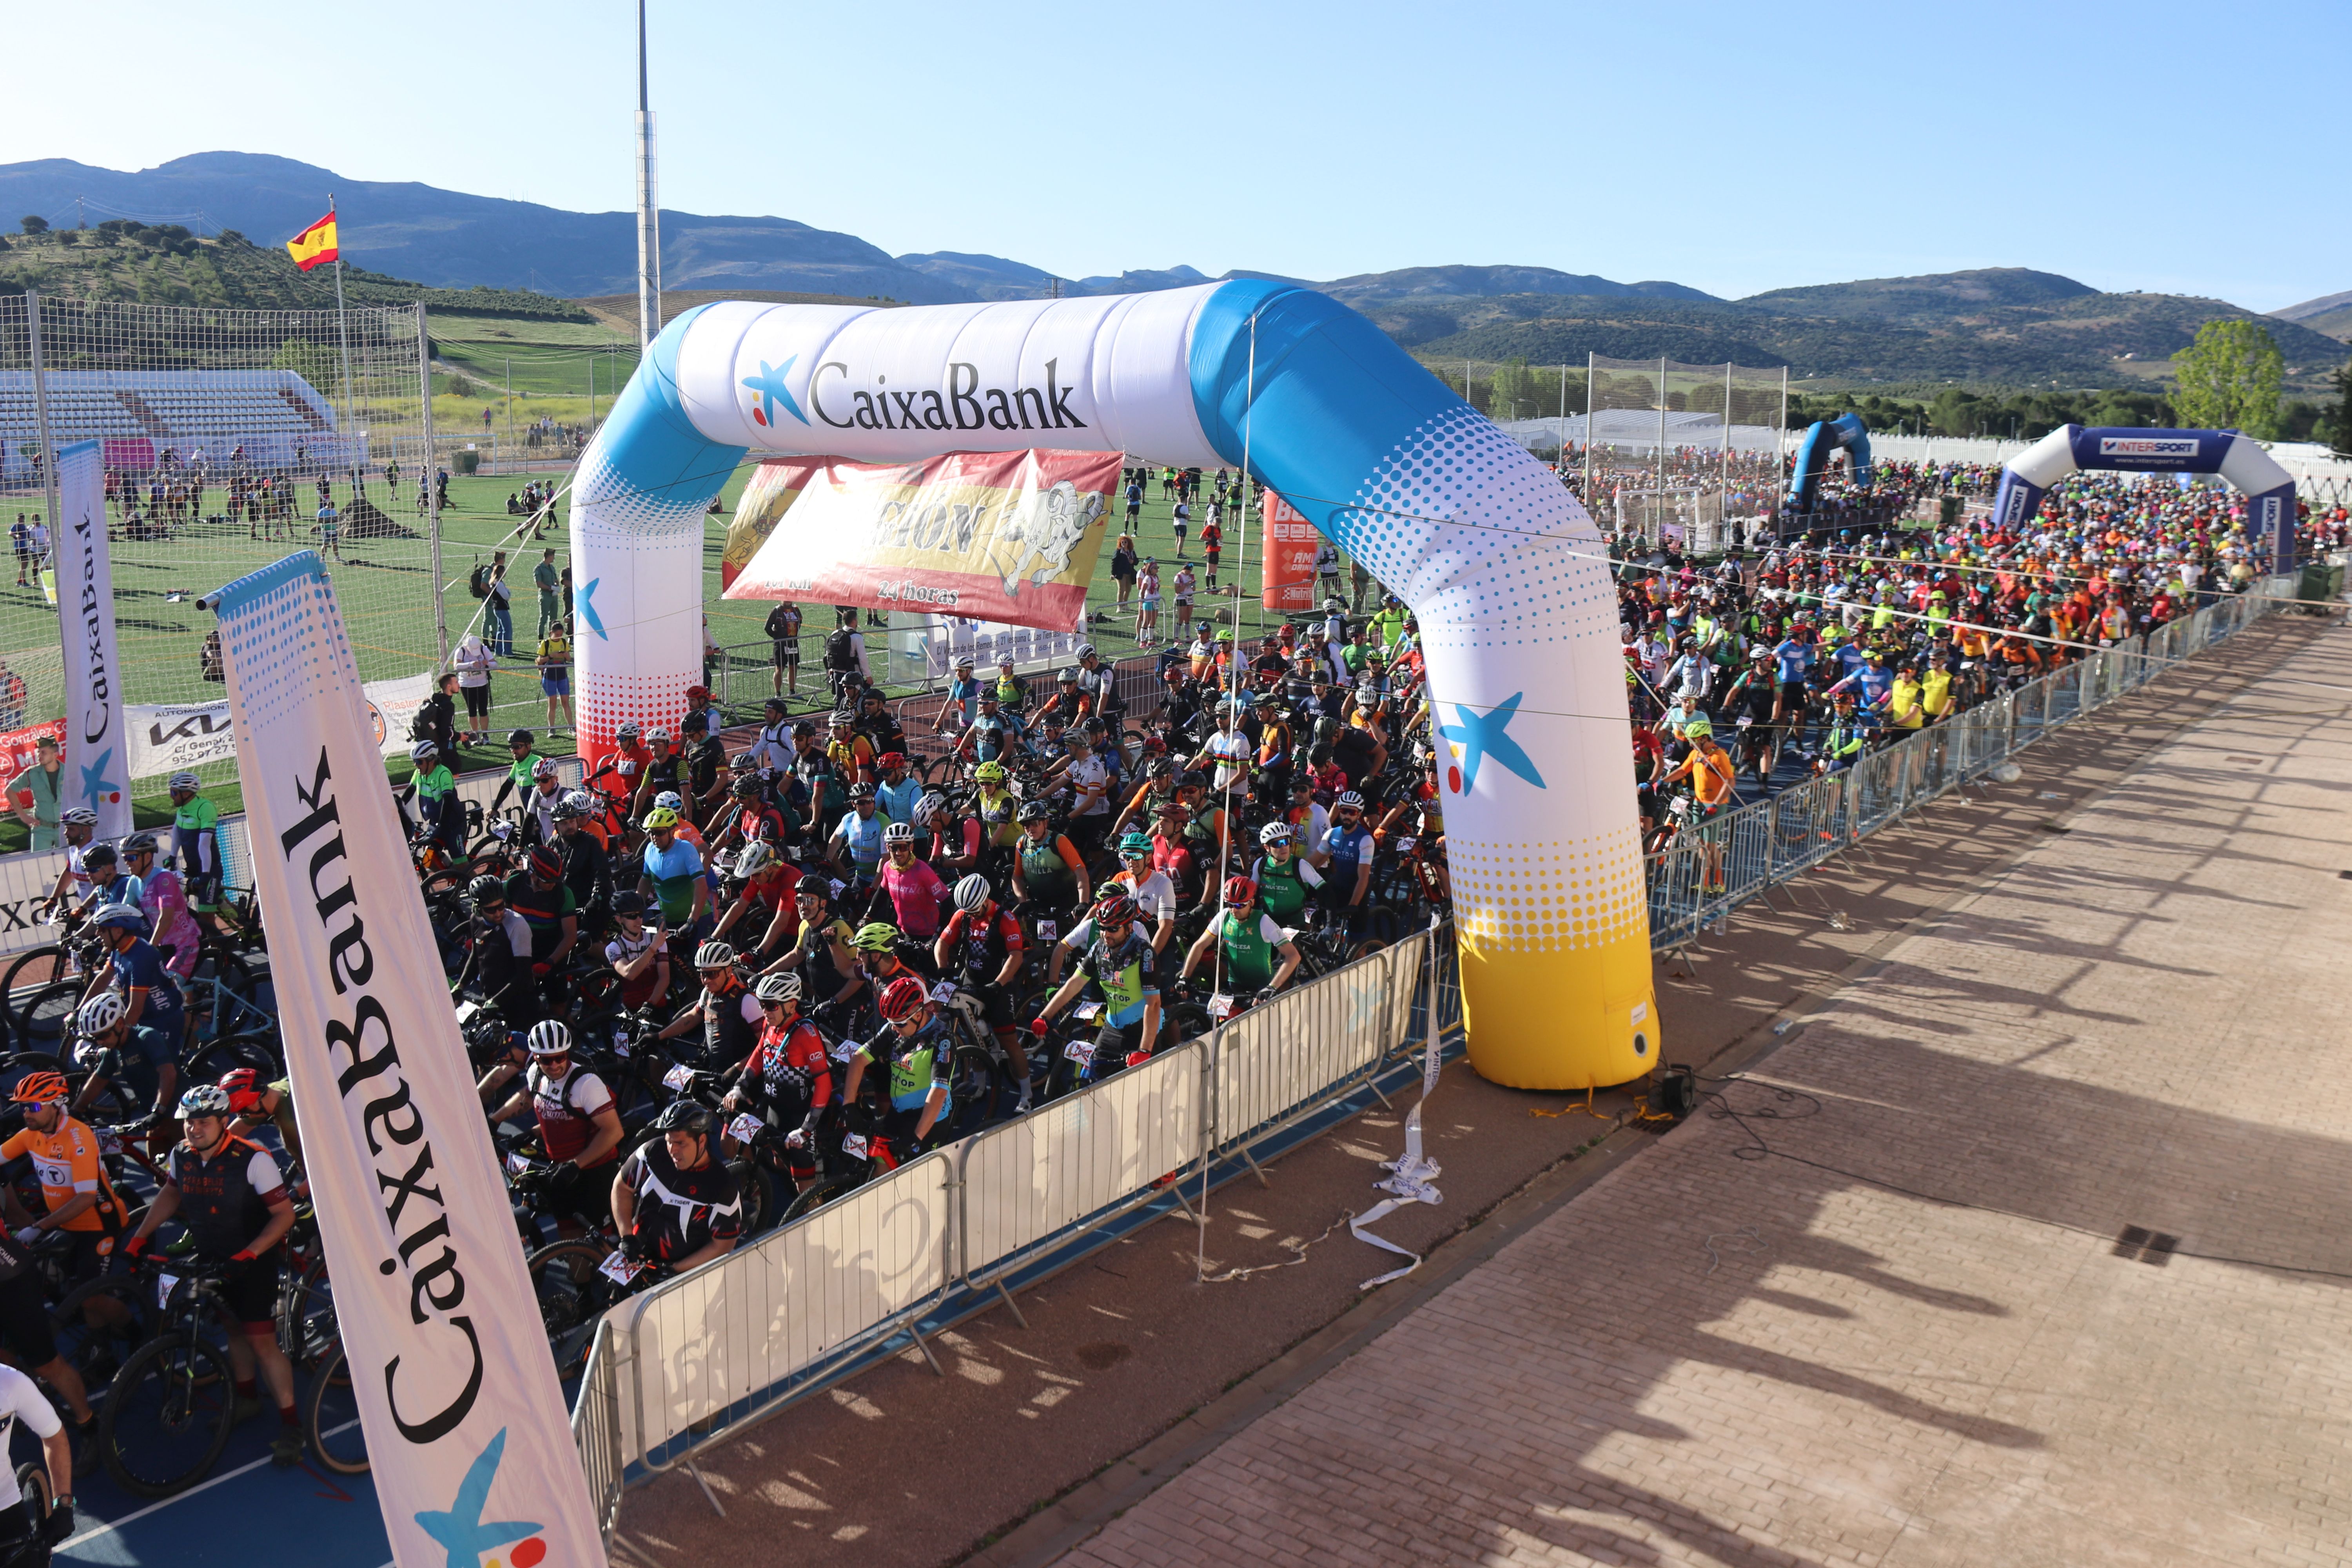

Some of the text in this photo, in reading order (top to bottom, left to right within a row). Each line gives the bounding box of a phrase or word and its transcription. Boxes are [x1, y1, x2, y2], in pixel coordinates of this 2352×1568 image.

[810, 358, 1087, 430] CaixaBank
[2118, 442, 2193, 452] INTERSPORT
[877, 580, 958, 605] 24 horas
[74, 501, 109, 744] CaixaBank
[960, 644, 967, 653] de
[1000, 636, 1006, 645] 21
[1007, 633, 1026, 645] (esquina
[0, 726, 54, 748] González
[189, 736, 225, 750] Genal,
[172, 753, 195, 764] 952
[215, 745, 228, 754] 27
[1200, 857, 1214, 869] am
[1228, 942, 1251, 950] NUCESA
[149, 985, 171, 1011] USAC
[281, 745, 485, 1446] CaixaBank
